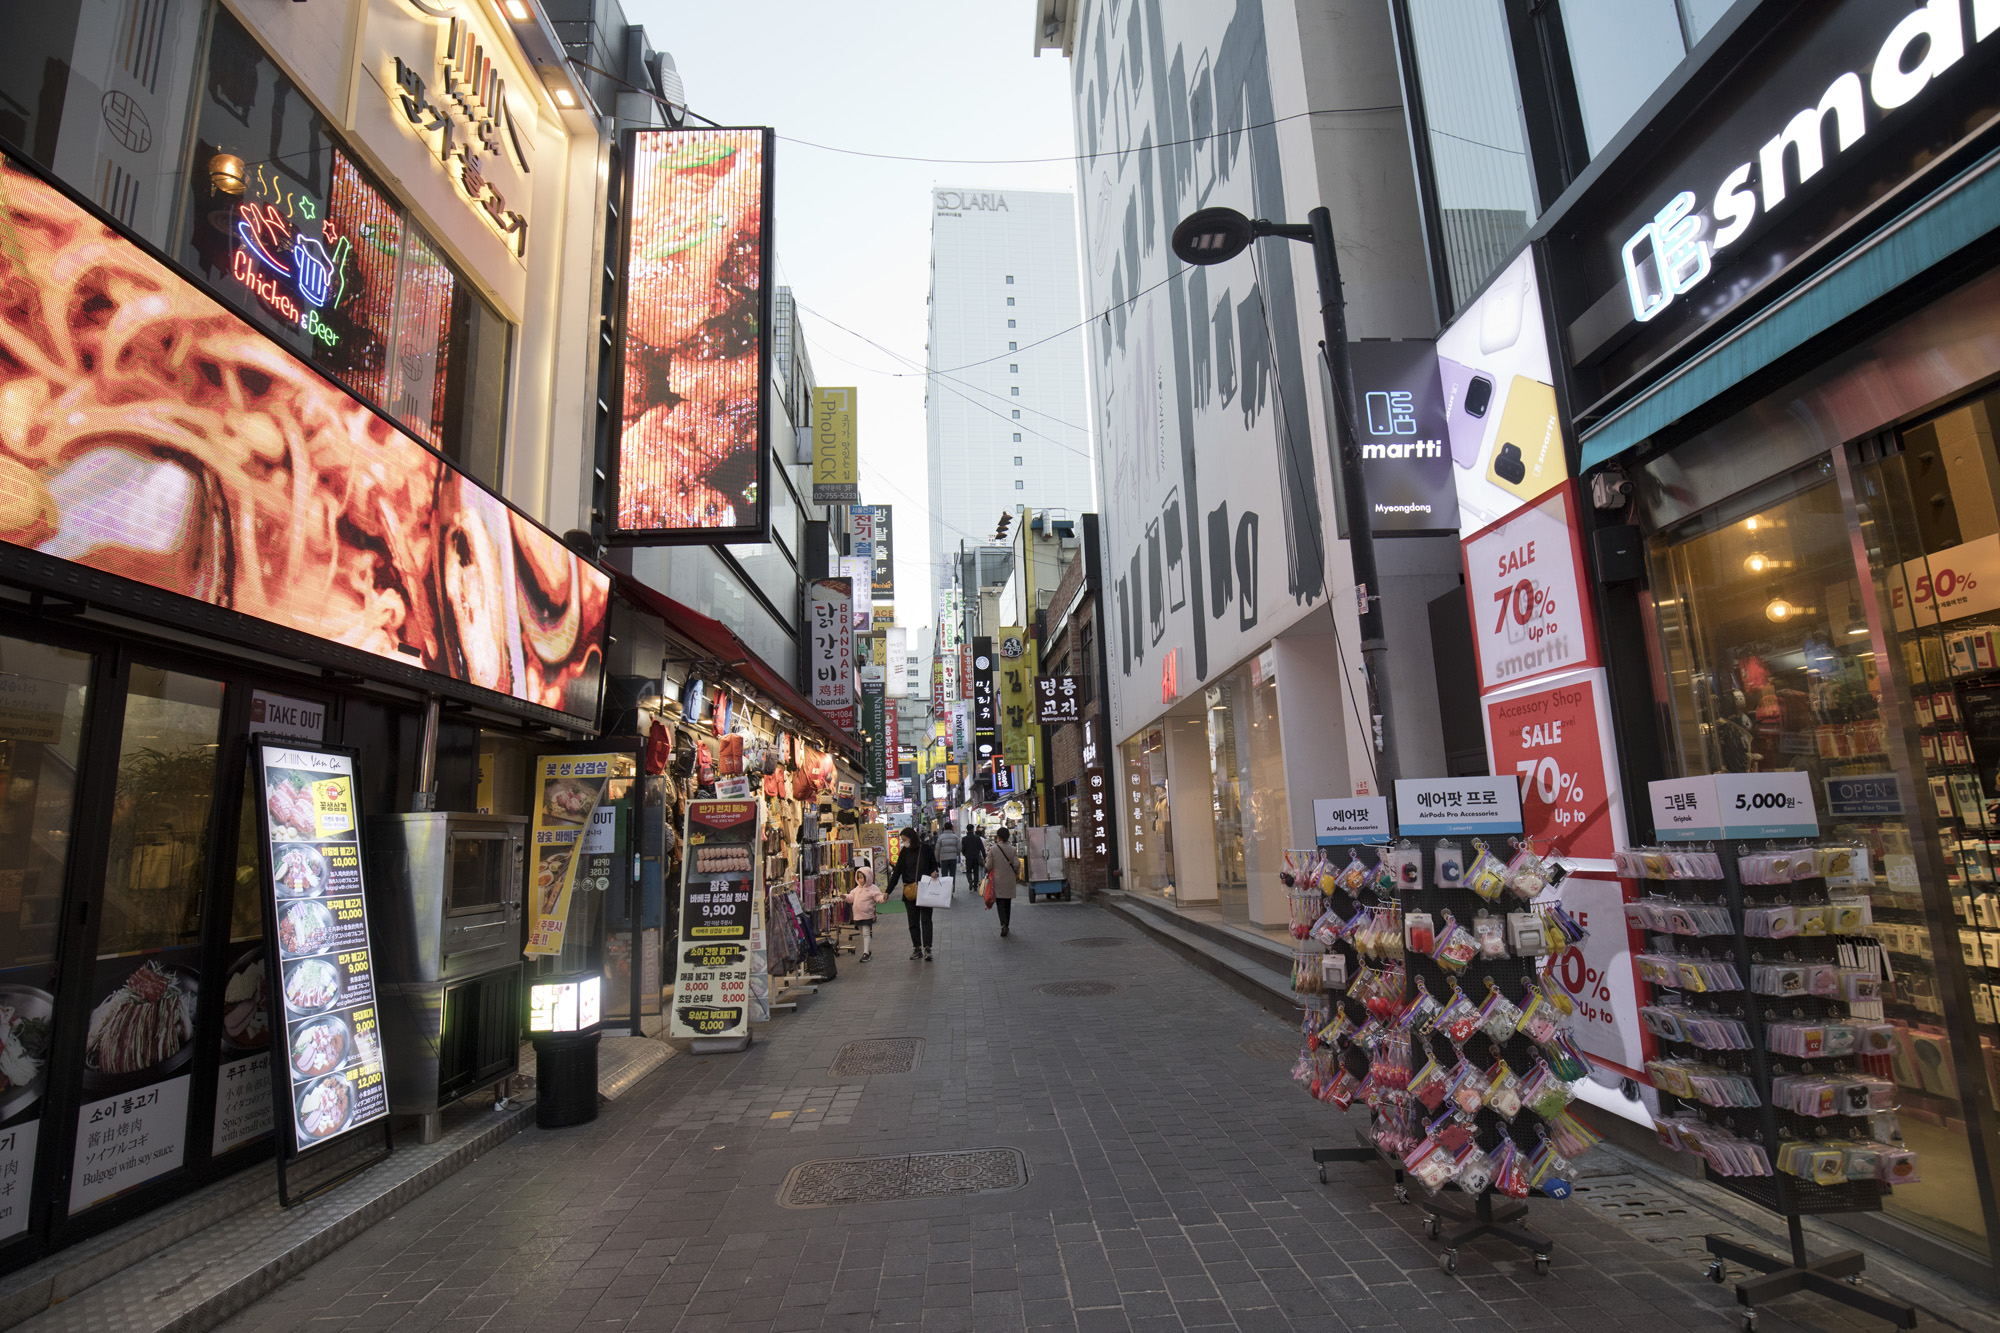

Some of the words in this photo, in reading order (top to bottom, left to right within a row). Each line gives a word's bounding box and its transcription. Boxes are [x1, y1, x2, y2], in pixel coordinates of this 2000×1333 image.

[1713, 0, 2000, 249] sma
[937, 192, 1009, 211] SOLARIA
[234, 249, 298, 323] Chicken
[308, 310, 339, 346] Beer
[820, 400, 836, 481] PhoDUCK
[1375, 502, 1431, 514] Myeongdong
[1498, 540, 1536, 578] SALE
[1494, 578, 1556, 635] 70%
[815, 601, 838, 681] 닭갈비
[946, 624, 954, 648] FOOD
[1529, 625, 1544, 643] Up
[1546, 622, 1558, 635] to
[840, 603, 849, 680] BBANDAK
[1495, 634, 1569, 679] smartti
[819, 684, 845, 696] 鸡排
[1040, 678, 1077, 696] 명동
[816, 697, 850, 706] bbandak
[1005, 669, 1024, 728] 김밥
[1041, 698, 1078, 716] 교자
[1499, 697, 1549, 720] Accessory
[1552, 690, 1582, 708] Shop
[268, 704, 298, 726] TAKE
[300, 709, 323, 730] OUT
[875, 697, 883, 730] Nature
[956, 714, 965, 750] baviphat
[1521, 720, 1562, 748] SALE
[311, 755, 328, 767] Van
[875, 732, 883, 784] Collection
[546, 763, 556, 776] 꽃
[559, 763, 572, 776] 생
[574, 761, 608, 776] 삼겹살
[1516, 756, 1584, 805] 70%
[1417, 791, 1463, 808] 에어팟
[1466, 790, 1498, 805] 프로
[1840, 782, 1887, 799] OPEN
[320, 801, 347, 812] 꽃생삼겹
[699, 805, 715, 814] 반가
[716, 804, 731, 813] 런치
[1664, 793, 1698, 811] 그립톡
[593, 812, 613, 825] OUT
[1332, 808, 1369, 823] 에어팟
[1419, 811, 1446, 819] AirPods
[1554, 808, 1570, 827] Up
[1574, 809, 1586, 822] to
[1673, 814, 1693, 823] Griptok
[1092, 792, 1107, 856] 명동교자
[536, 830, 553, 843] 참숯
[333, 857, 357, 868] 10,000
[710, 879, 730, 892] 참숯
[690, 893, 711, 903] 바베큐
[712, 892, 733, 903] 삼겹살
[734, 892, 749, 903] 정식
[338, 908, 363, 920] 10,000
[702, 904, 736, 918] 9,900
[540, 920, 563, 933] 주문시
[690, 947, 704, 956] 소이
[719, 946, 740, 956] 불고기
[348, 961, 369, 974] 9,000
[702, 956, 726, 966] 8,000
[695, 972, 715, 981] 불고기
[719, 971, 733, 980] 한우
[685, 982, 709, 992] 8,000
[720, 981, 744, 991] 8,000
[678, 994, 692, 1003] 초당
[693, 994, 713, 1003] 순두부
[722, 993, 746, 1004] 8,000
[1580, 1001, 1596, 1022] Up
[1600, 1010, 1613, 1024] to
[356, 1019, 375, 1033] 9,000
[699, 1020, 724, 1031] 8,000
[357, 1072, 381, 1089] 12,000
[90, 1101, 117, 1124] 소이
[122, 1089, 159, 1113] 불고기
[222, 1117, 243, 1130] Spicy
[221, 1132, 238, 1143] with
[239, 1123, 258, 1136] small
[83, 1164, 117, 1187] Bulgogi
[119, 1157, 137, 1171] with
[138, 1153, 152, 1167] soy
[153, 1144, 175, 1159] sauce
